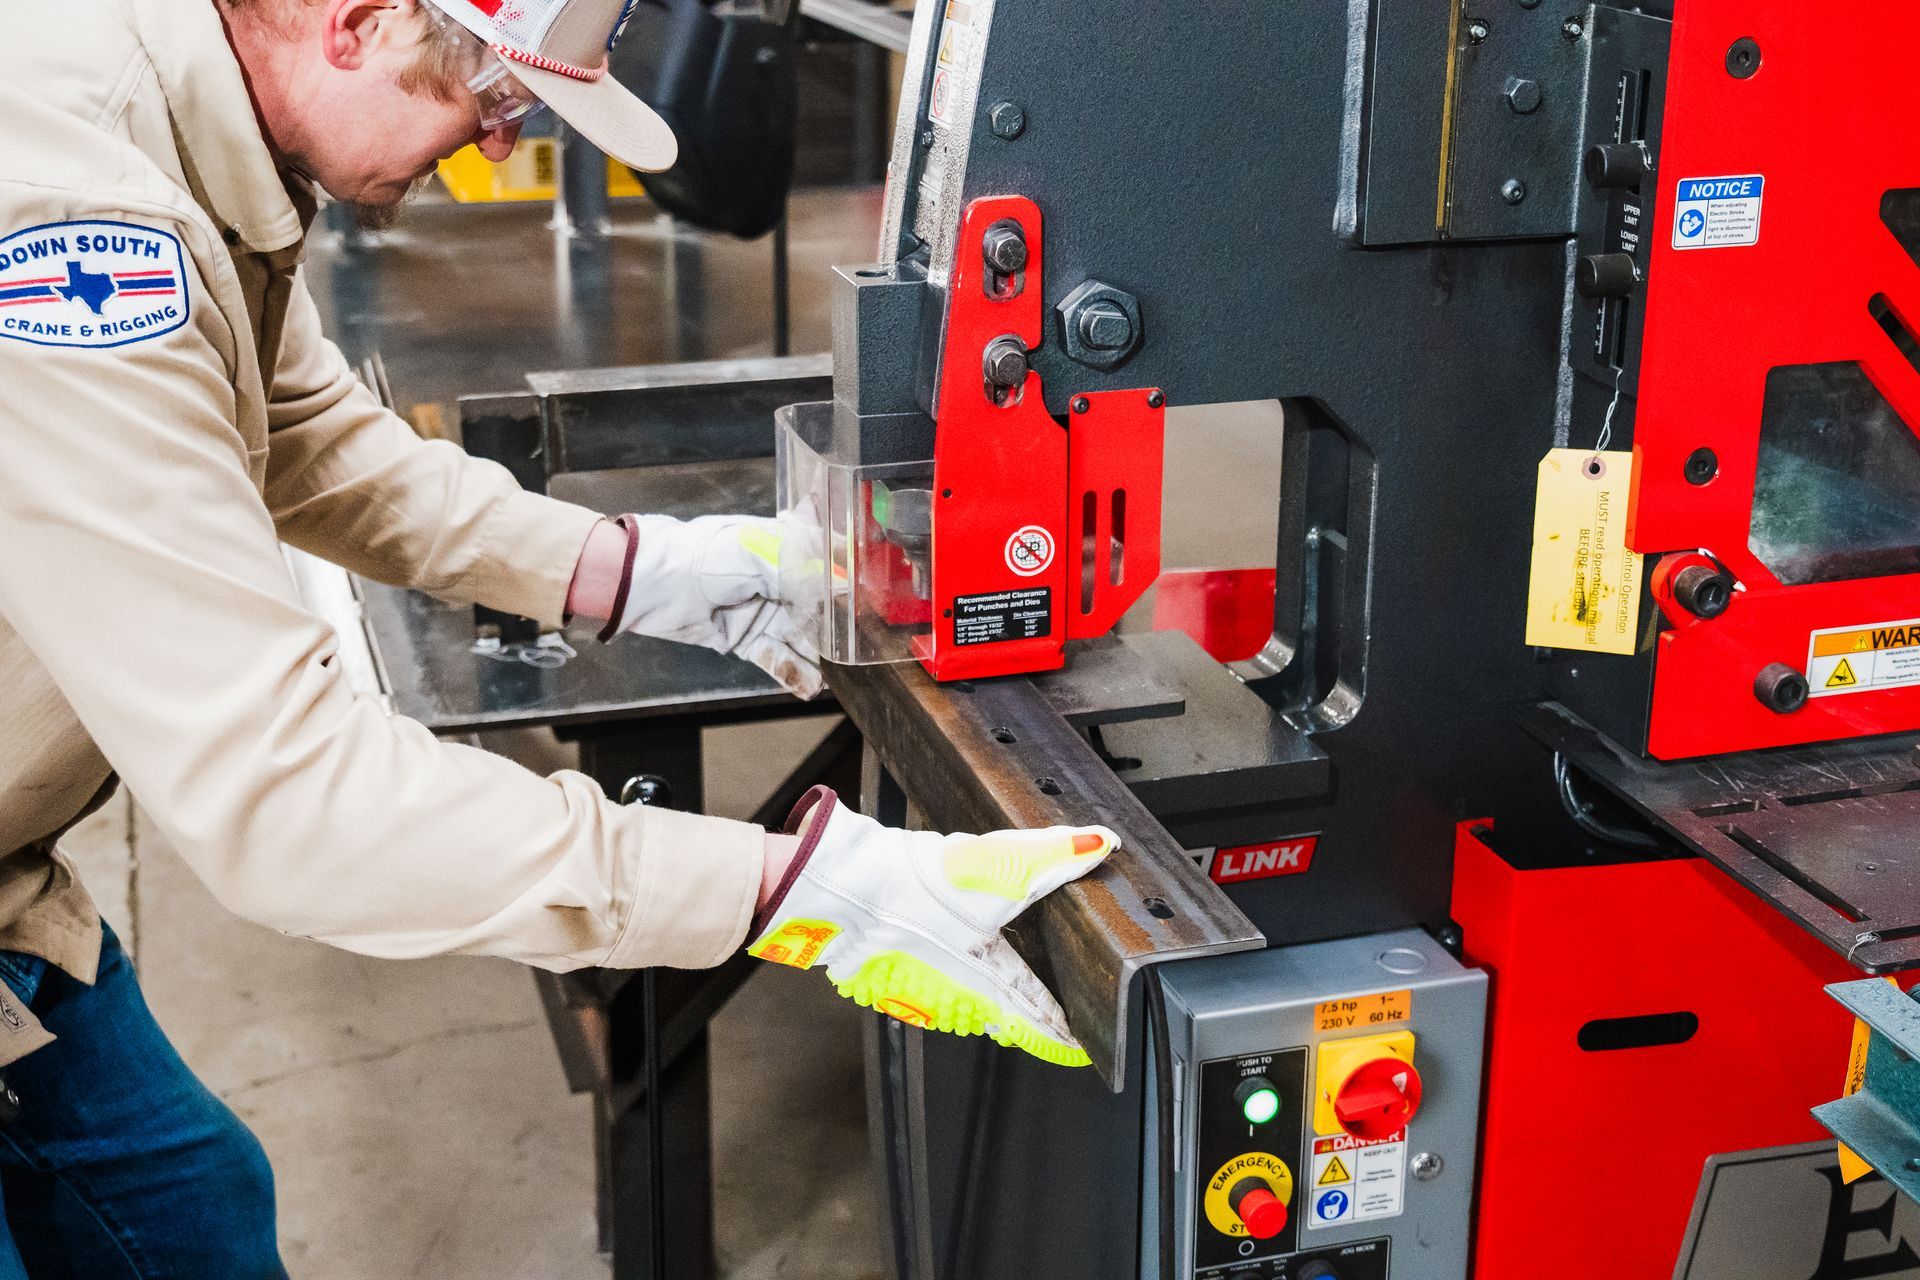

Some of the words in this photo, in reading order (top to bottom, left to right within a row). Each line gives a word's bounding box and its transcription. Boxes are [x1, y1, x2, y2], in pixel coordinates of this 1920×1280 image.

[1689, 181, 1752, 198] NOTICE
[1623, 203, 1640, 216] UPPER
[1624, 215, 1638, 226] LIMIT
[1620, 229, 1639, 243] LOWER
[1622, 241, 1635, 253] LIMIT
[0, 237, 67, 271] DOWN
[76, 235, 161, 259] SOUTH
[5, 318, 73, 336] CRANE
[80, 325, 94, 337] &
[100, 305, 178, 336] RIGGING
[1599, 491, 1610, 523] MUST
[1578, 528, 1591, 569] BEFORE
[1595, 527, 1606, 550] read
[1624, 551, 1634, 582] ontrol
[1590, 553, 1603, 612] operations
[958, 593, 1010, 604] Recommended
[1012, 590, 1047, 599] Clearance
[977, 603, 1009, 611] Punches
[1010, 600, 1024, 608] and
[1617, 584, 1633, 634] Operation
[1587, 612, 1599, 644] manual
[1220, 845, 1304, 877] LINK
[1321, 1002, 1338, 1014] 7.5
[1341, 1001, 1357, 1012] hp
[1321, 1018, 1342, 1030] 230
[1346, 1015, 1355, 1026] V
[1369, 1012, 1384, 1022] 60
[1387, 1010, 1402, 1020] Hz
[1260, 1055, 1272, 1065] TO
[1213, 1156, 1286, 1191] EMERGENCY
